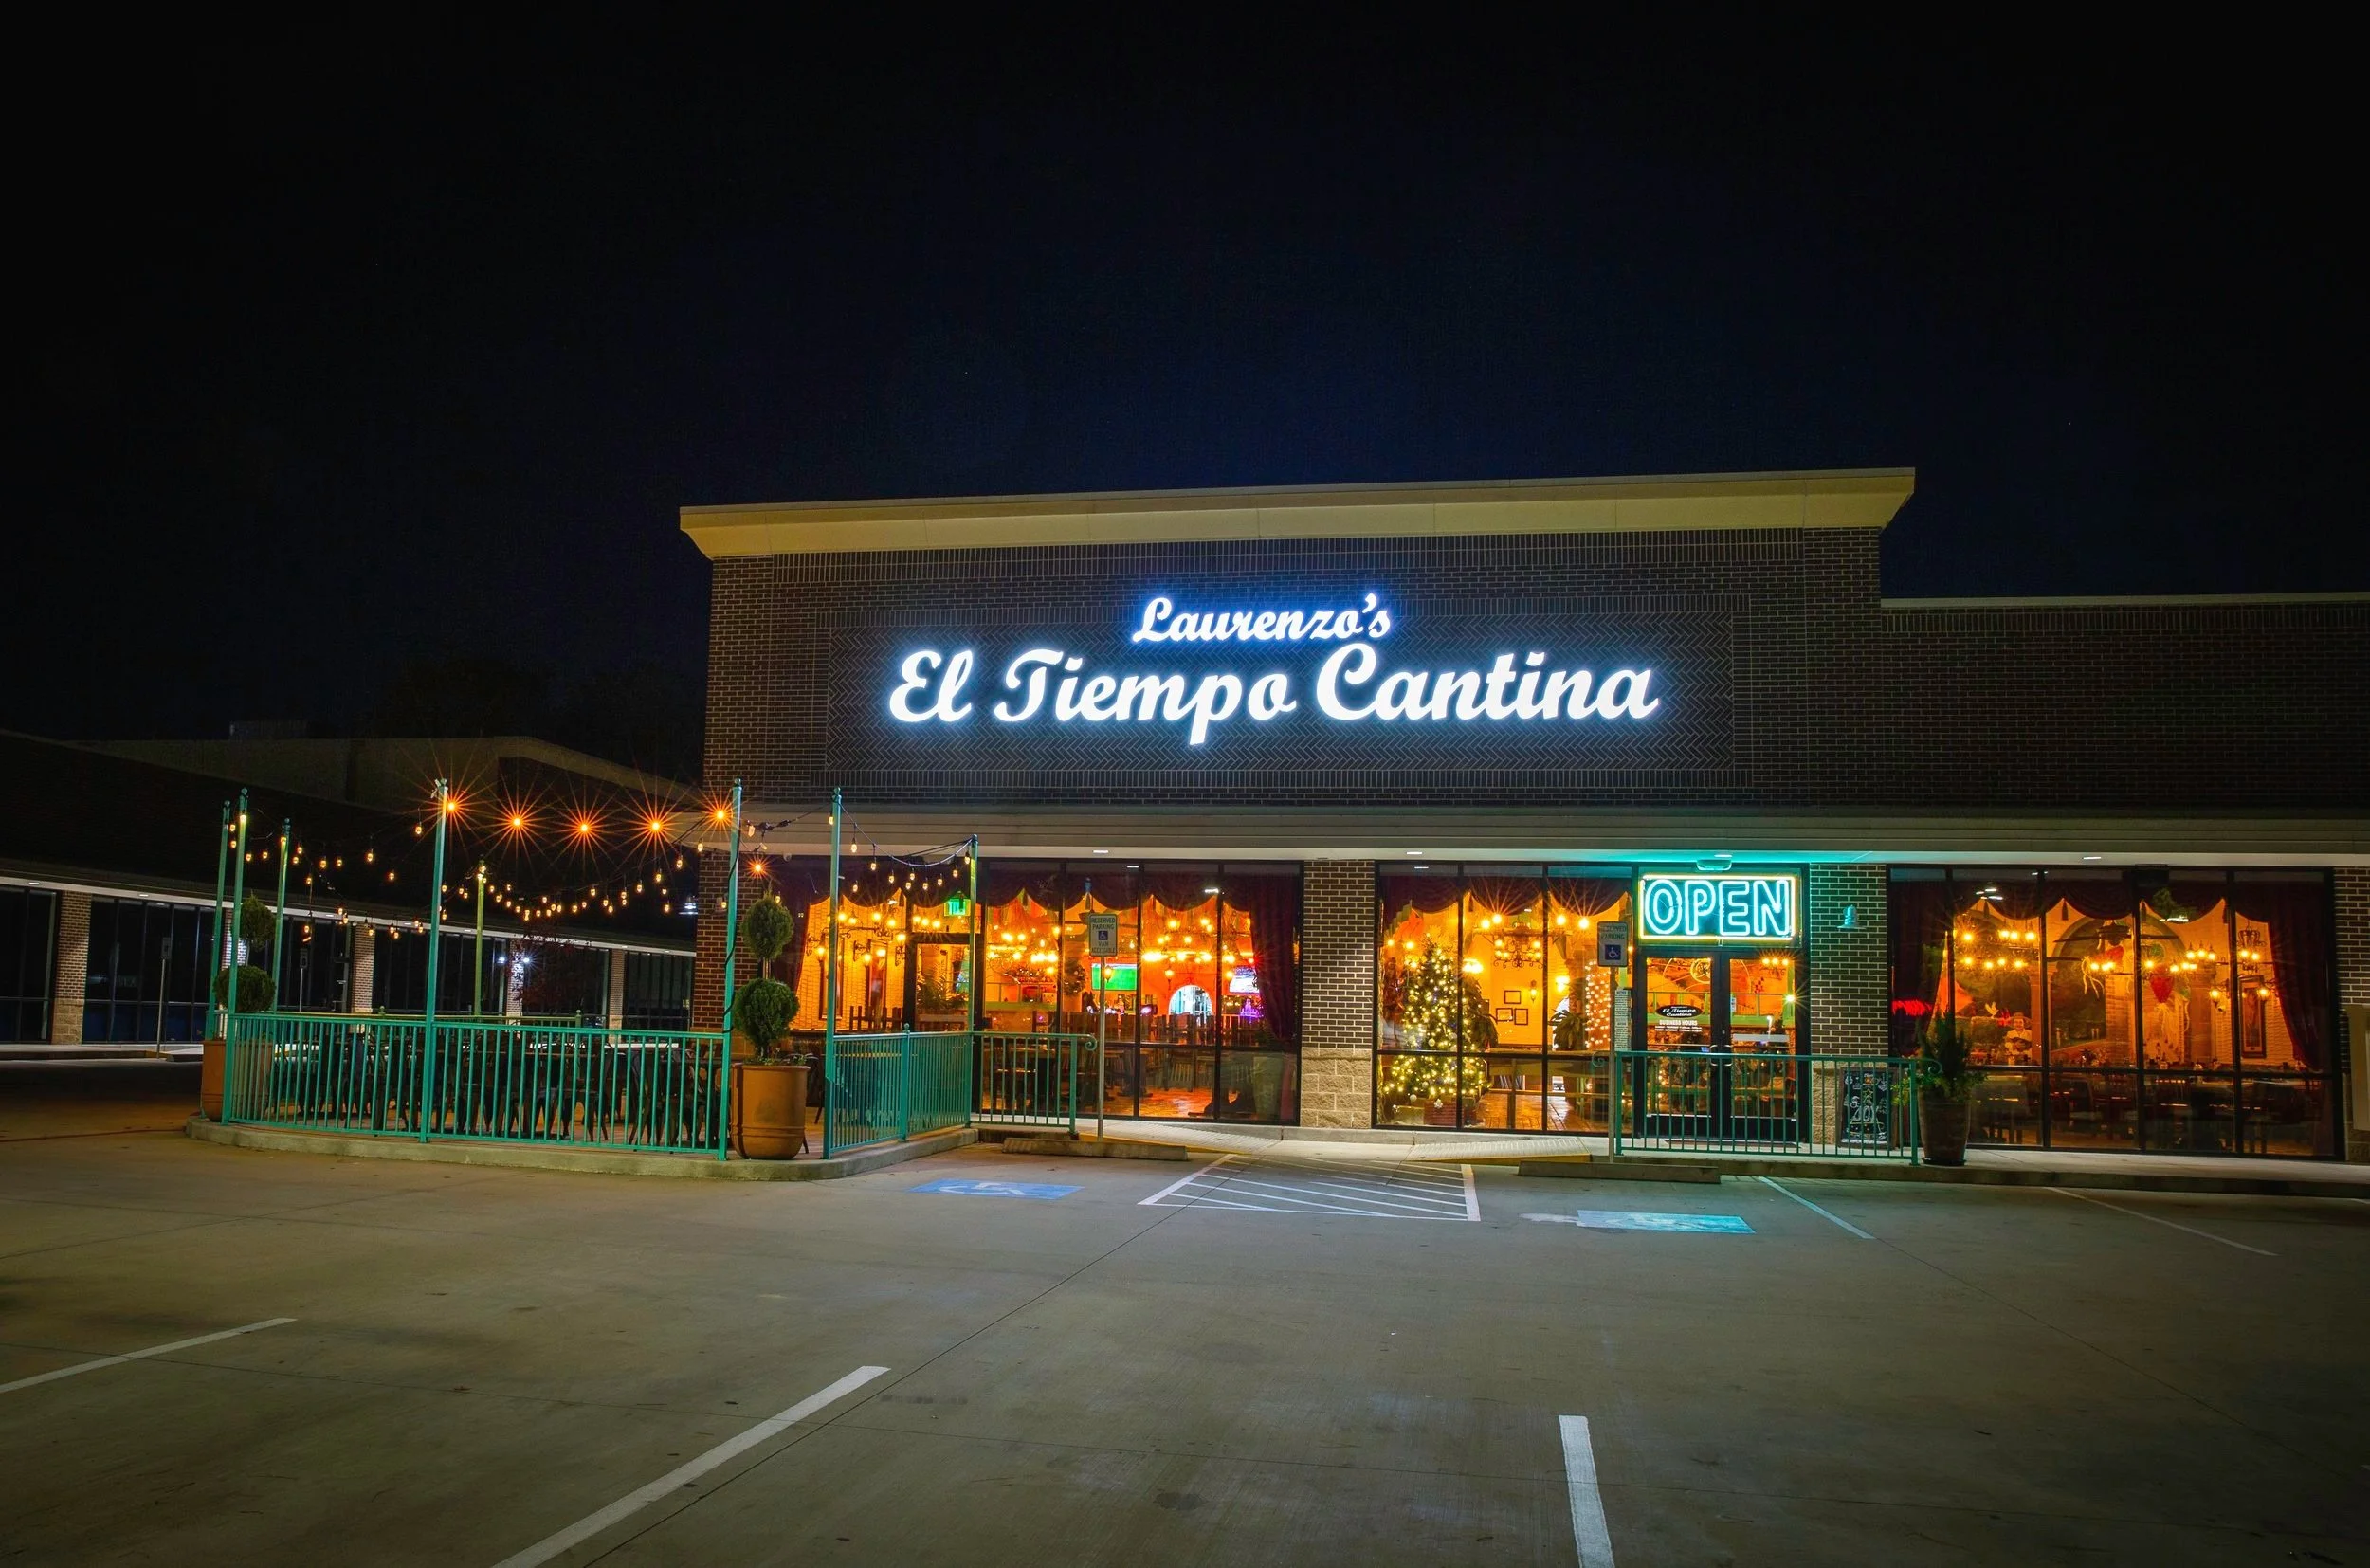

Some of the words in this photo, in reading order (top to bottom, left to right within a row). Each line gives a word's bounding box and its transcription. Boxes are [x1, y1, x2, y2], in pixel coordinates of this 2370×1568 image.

[1131, 593, 1392, 643] Laurenzo's
[888, 649, 974, 722] El
[993, 648, 1297, 746] Tiempo
[1315, 643, 1660, 721] Cantina
[1644, 879, 1791, 936] OPEN
